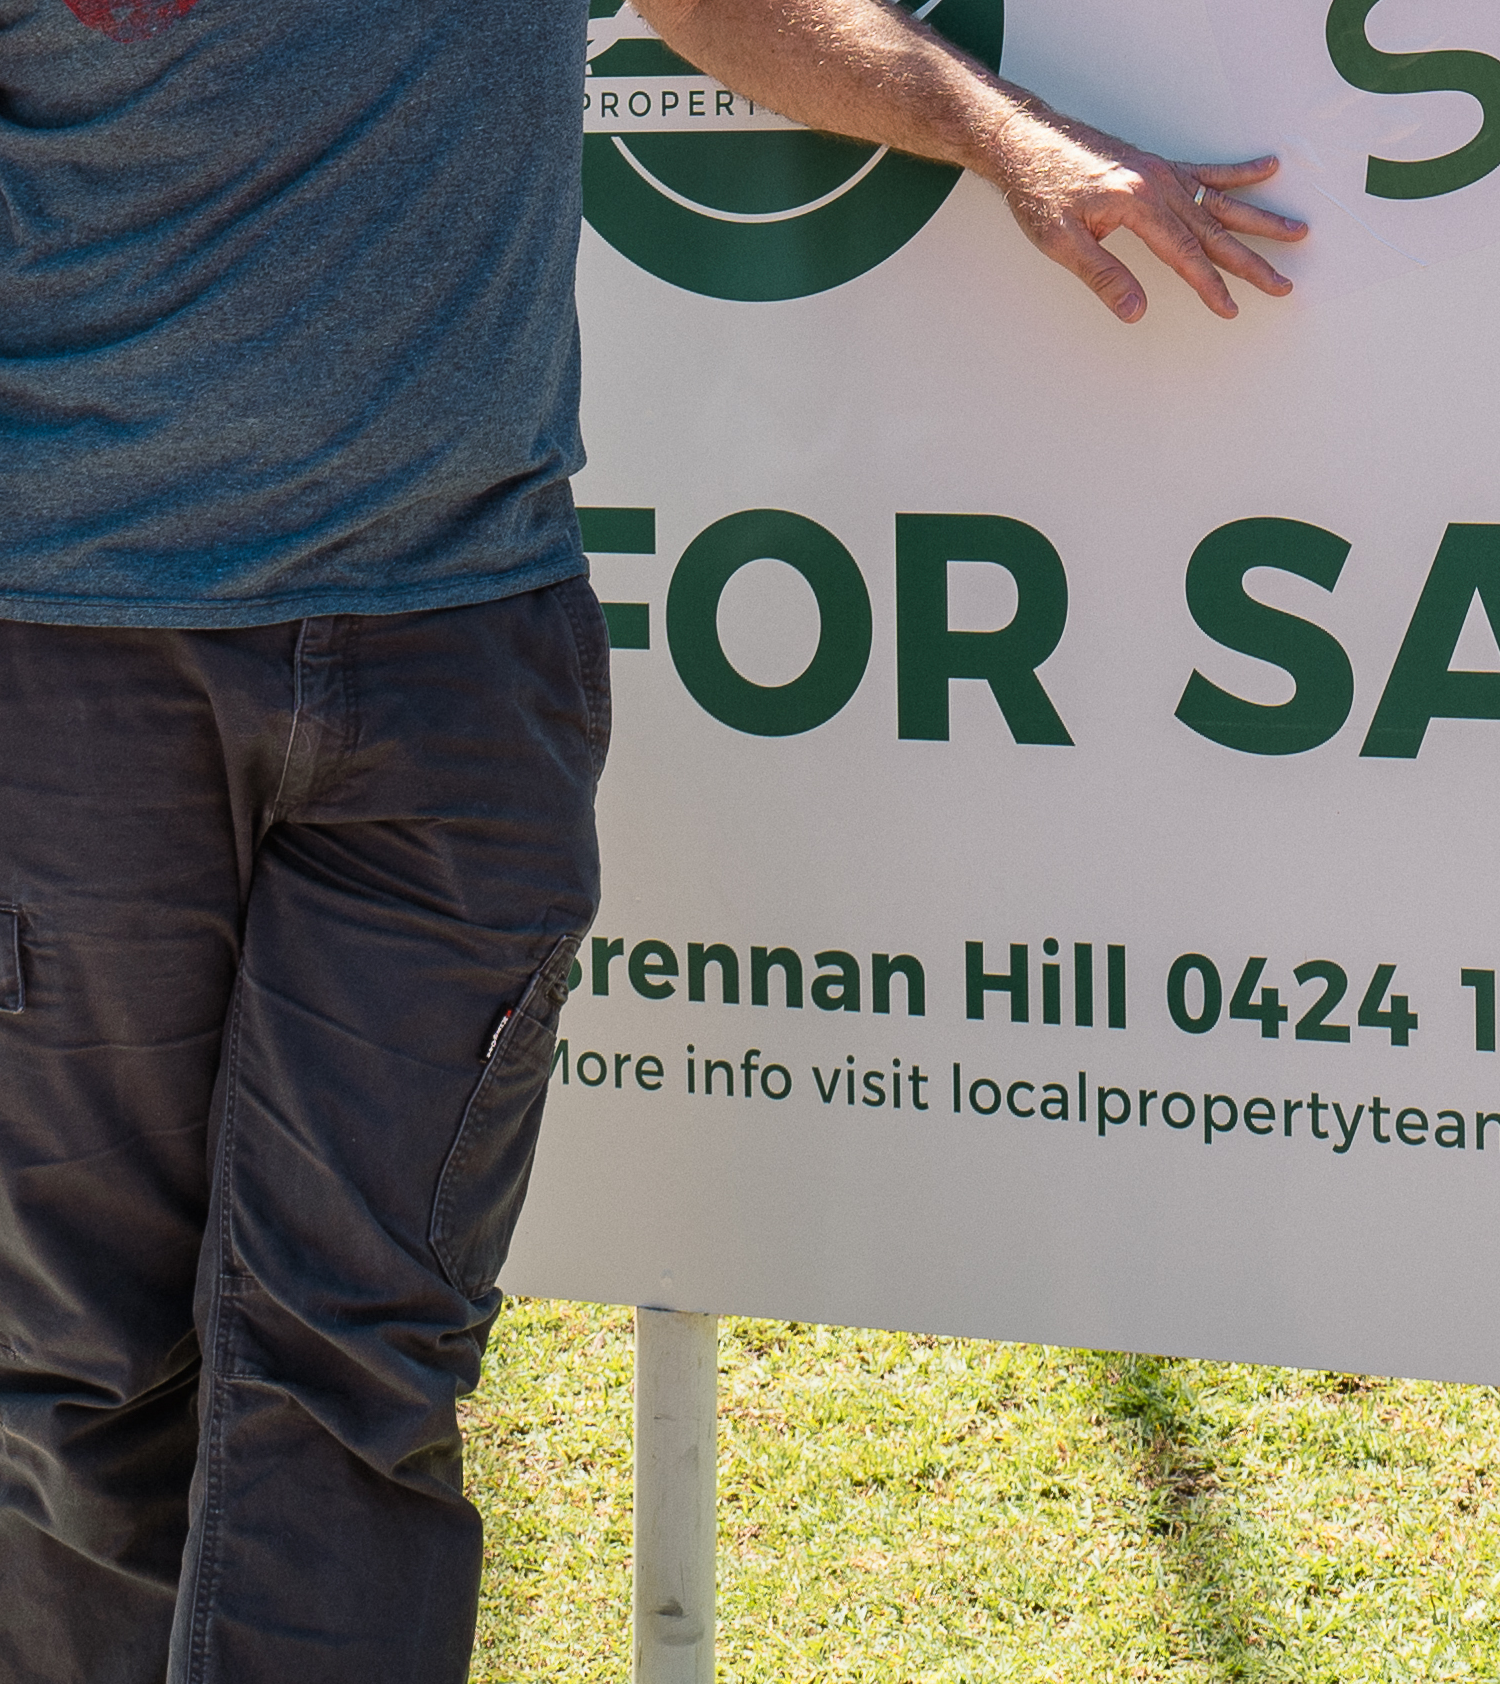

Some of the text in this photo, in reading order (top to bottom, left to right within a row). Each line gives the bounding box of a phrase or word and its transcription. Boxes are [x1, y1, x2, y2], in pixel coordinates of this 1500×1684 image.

[583, 90, 779, 118] ROPER
[575, 506, 1076, 748] OR
[566, 936, 927, 1017] rennan
[964, 937, 1128, 1030] Hill
[1166, 952, 1420, 1048] 0424
[686, 1043, 793, 1102] info
[812, 1054, 930, 1112] visit
